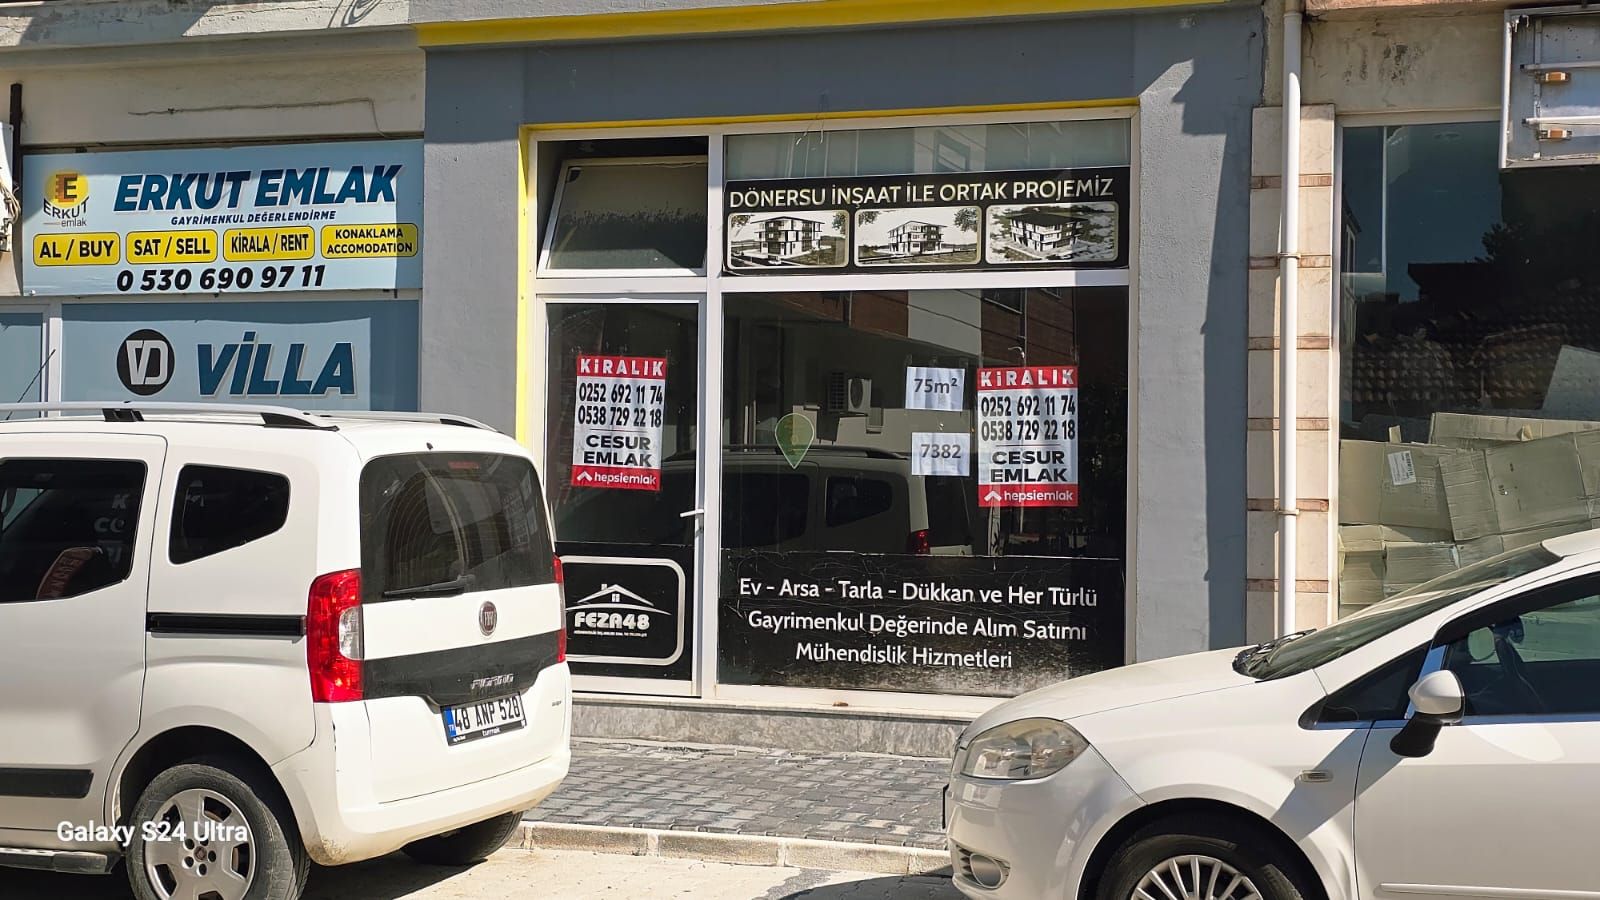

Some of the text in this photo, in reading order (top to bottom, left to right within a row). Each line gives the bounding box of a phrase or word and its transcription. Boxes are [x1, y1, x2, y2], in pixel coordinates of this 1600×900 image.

[113, 165, 402, 212] ERKUT EMLAK
[729, 175, 1113, 209] DÖNERSU İNŞAAT İLE ORTAK PROJEMİZ
[43, 196, 89, 219] ERKUT
[171, 209, 336, 226] GAYRİMENKUL DEĞERLENDİRME
[61, 218, 87, 227] emlak
[231, 233, 271, 254] KİRALA
[281, 233, 310, 252] RENT
[335, 228, 403, 240] KONAKLAMA
[39, 241, 62, 258] AL
[79, 240, 114, 258] BUY
[134, 239, 161, 256] SAT
[175, 237, 211, 255] SELL
[327, 240, 413, 255] ACCOMODATION
[117, 264, 325, 291] 0 530 690 97 11
[197, 331, 355, 396] VİLLA
[579, 383, 663, 405] 0252 692 11 74
[981, 394, 1075, 417] 0252 692 11 74
[578, 406, 662, 427] 0538 729 22 18
[981, 419, 1076, 441] 0538 729 22 18
[586, 434, 651, 450] CESUR
[920, 444, 961, 459] 7382
[584, 451, 652, 467] EMLAK
[992, 450, 1065, 465] CESUR
[594, 471, 656, 485] hepsiemlak
[990, 468, 1067, 483] EMLAK
[1004, 489, 1073, 504] hepsiemlak
[739, 578, 762, 596] Ev
[779, 579, 820, 597] Arsa
[838, 580, 883, 600] Tarla
[902, 583, 974, 602] Dükkan
[979, 590, 1003, 603] ve
[1008, 587, 1043, 605] Her
[1048, 587, 1097, 607] Türlü
[574, 612, 650, 630] FEZA48
[748, 610, 1086, 641] Gayrimenkul Değerinde Alım Satımı
[796, 642, 1012, 669] Mühendislik Hizmetleri
[455, 708, 471, 731] 48
[475, 702, 496, 727] ANP
